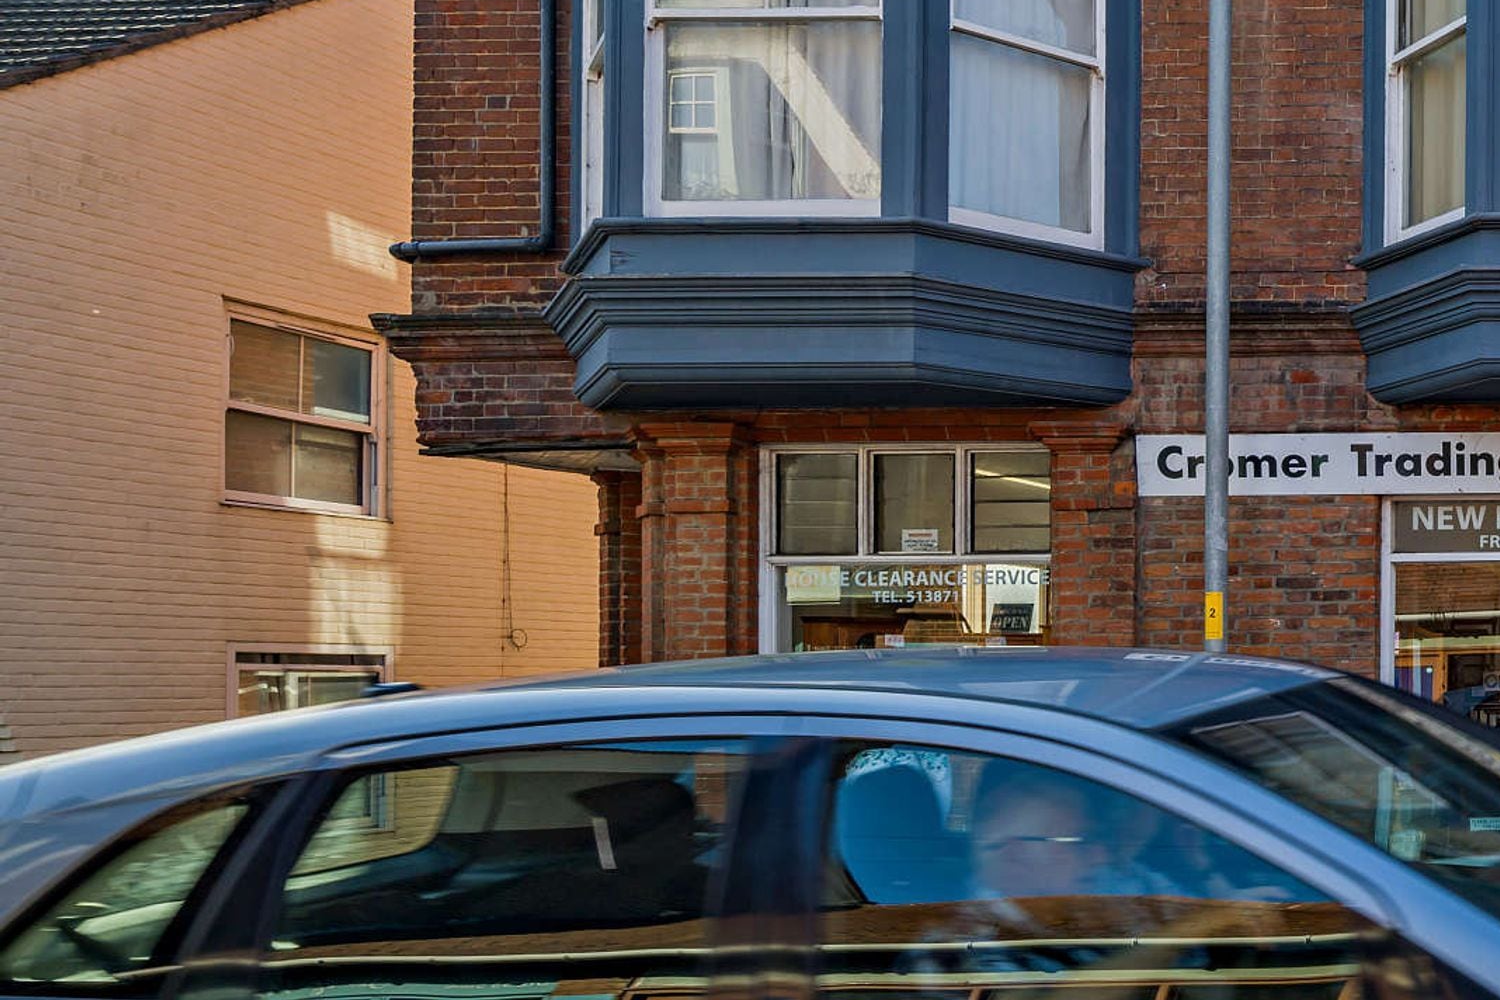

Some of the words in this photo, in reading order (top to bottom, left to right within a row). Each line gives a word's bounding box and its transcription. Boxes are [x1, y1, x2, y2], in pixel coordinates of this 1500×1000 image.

[1157, 445, 1329, 479] Crmer
[1411, 505, 1487, 531] NEW
[854, 570, 967, 587] CLEARANCE
[973, 569, 1050, 585] SERVICE
[871, 590, 903, 603] TEL.
[906, 590, 959, 603] 513871
[1209, 607, 1216, 619] 2
[991, 616, 1030, 629] OPEN
